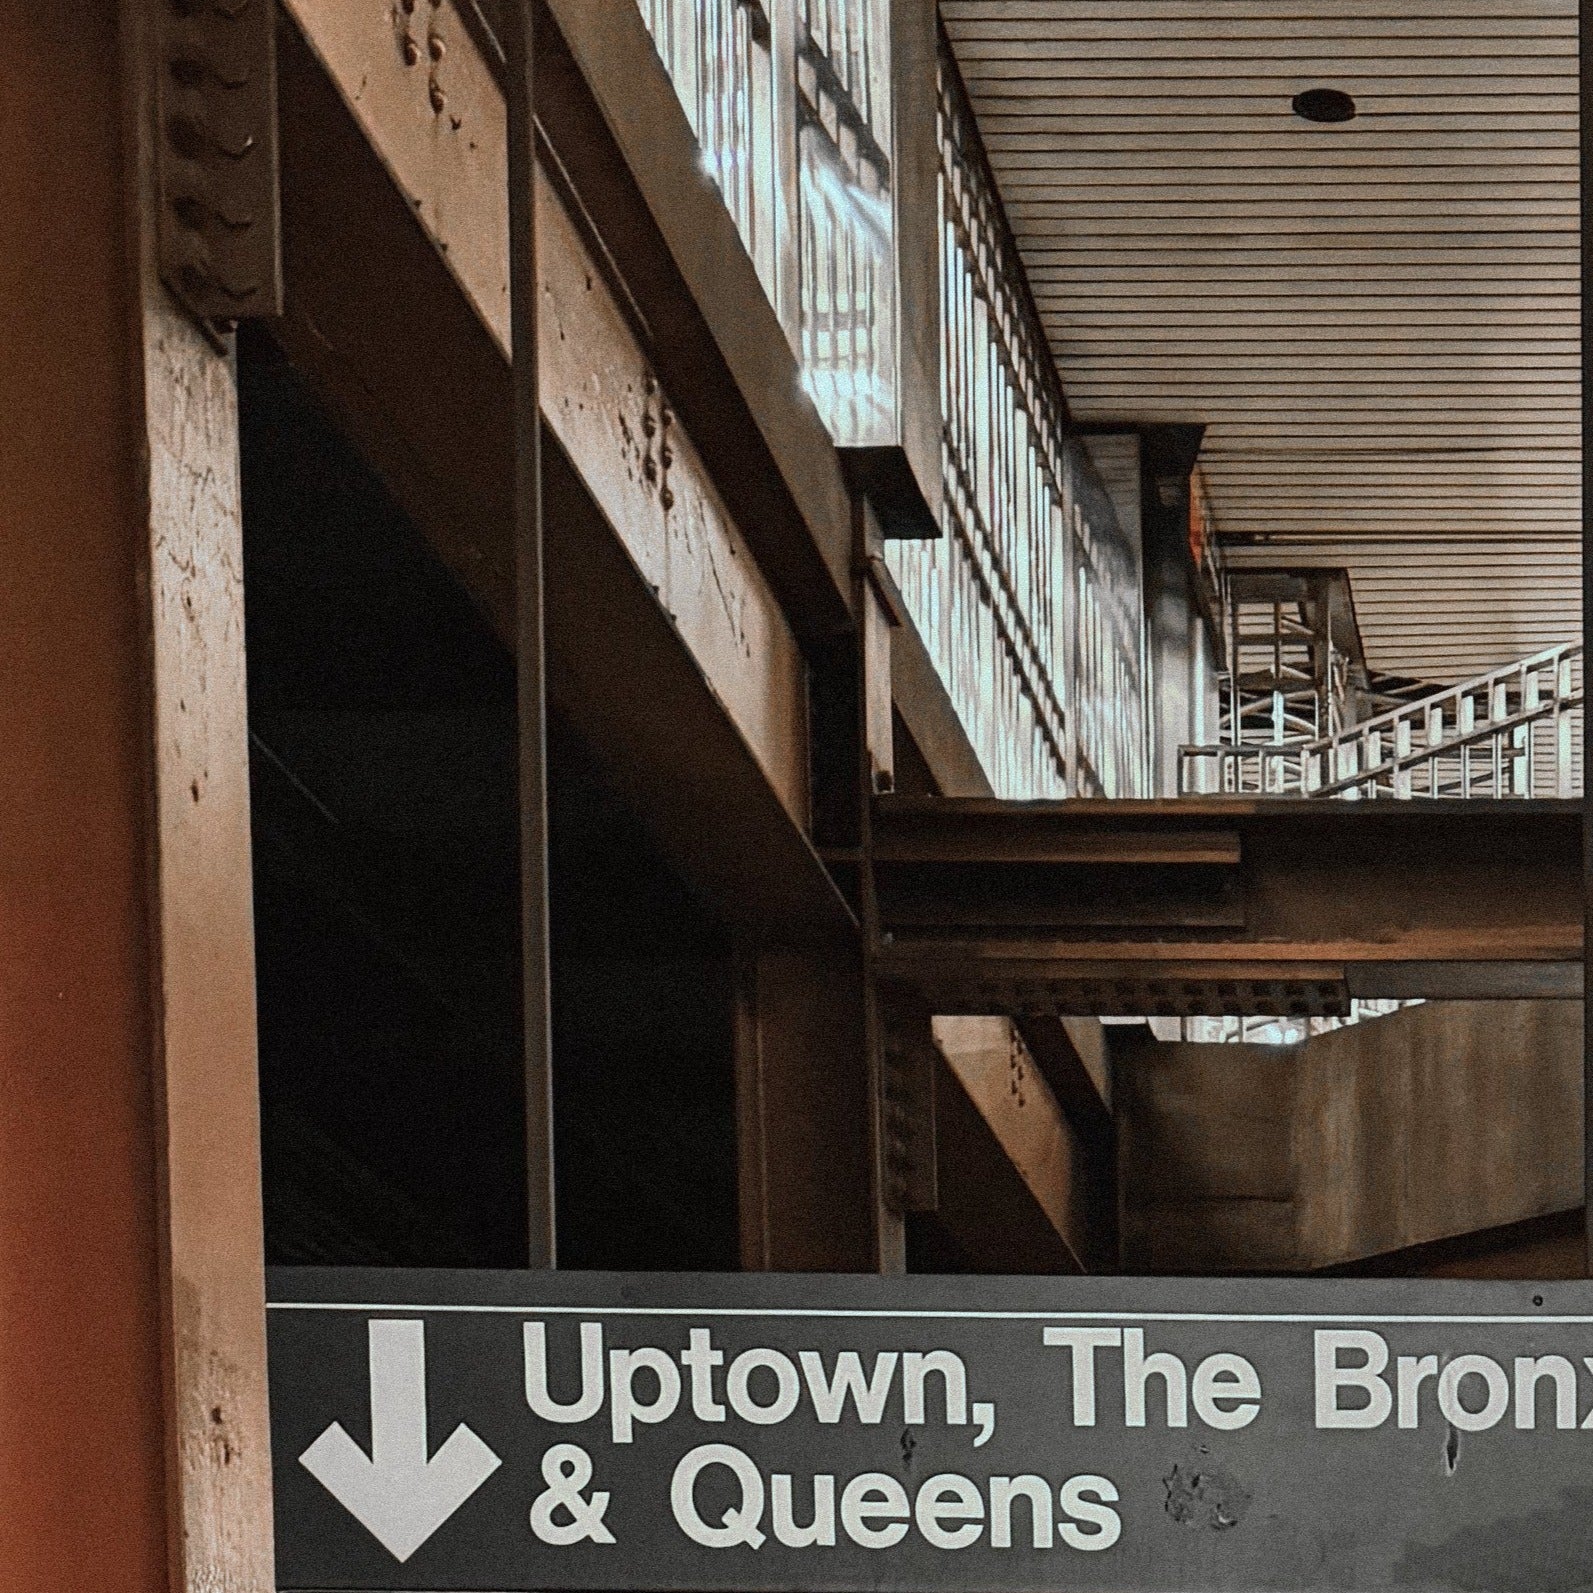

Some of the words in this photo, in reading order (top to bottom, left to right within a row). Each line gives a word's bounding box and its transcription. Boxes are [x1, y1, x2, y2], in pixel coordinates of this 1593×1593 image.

[522, 1321, 995, 1448] Uptown,
[1042, 1326, 1262, 1431] The
[529, 1443, 617, 1546] &
[670, 1443, 1122, 1552] Queens
